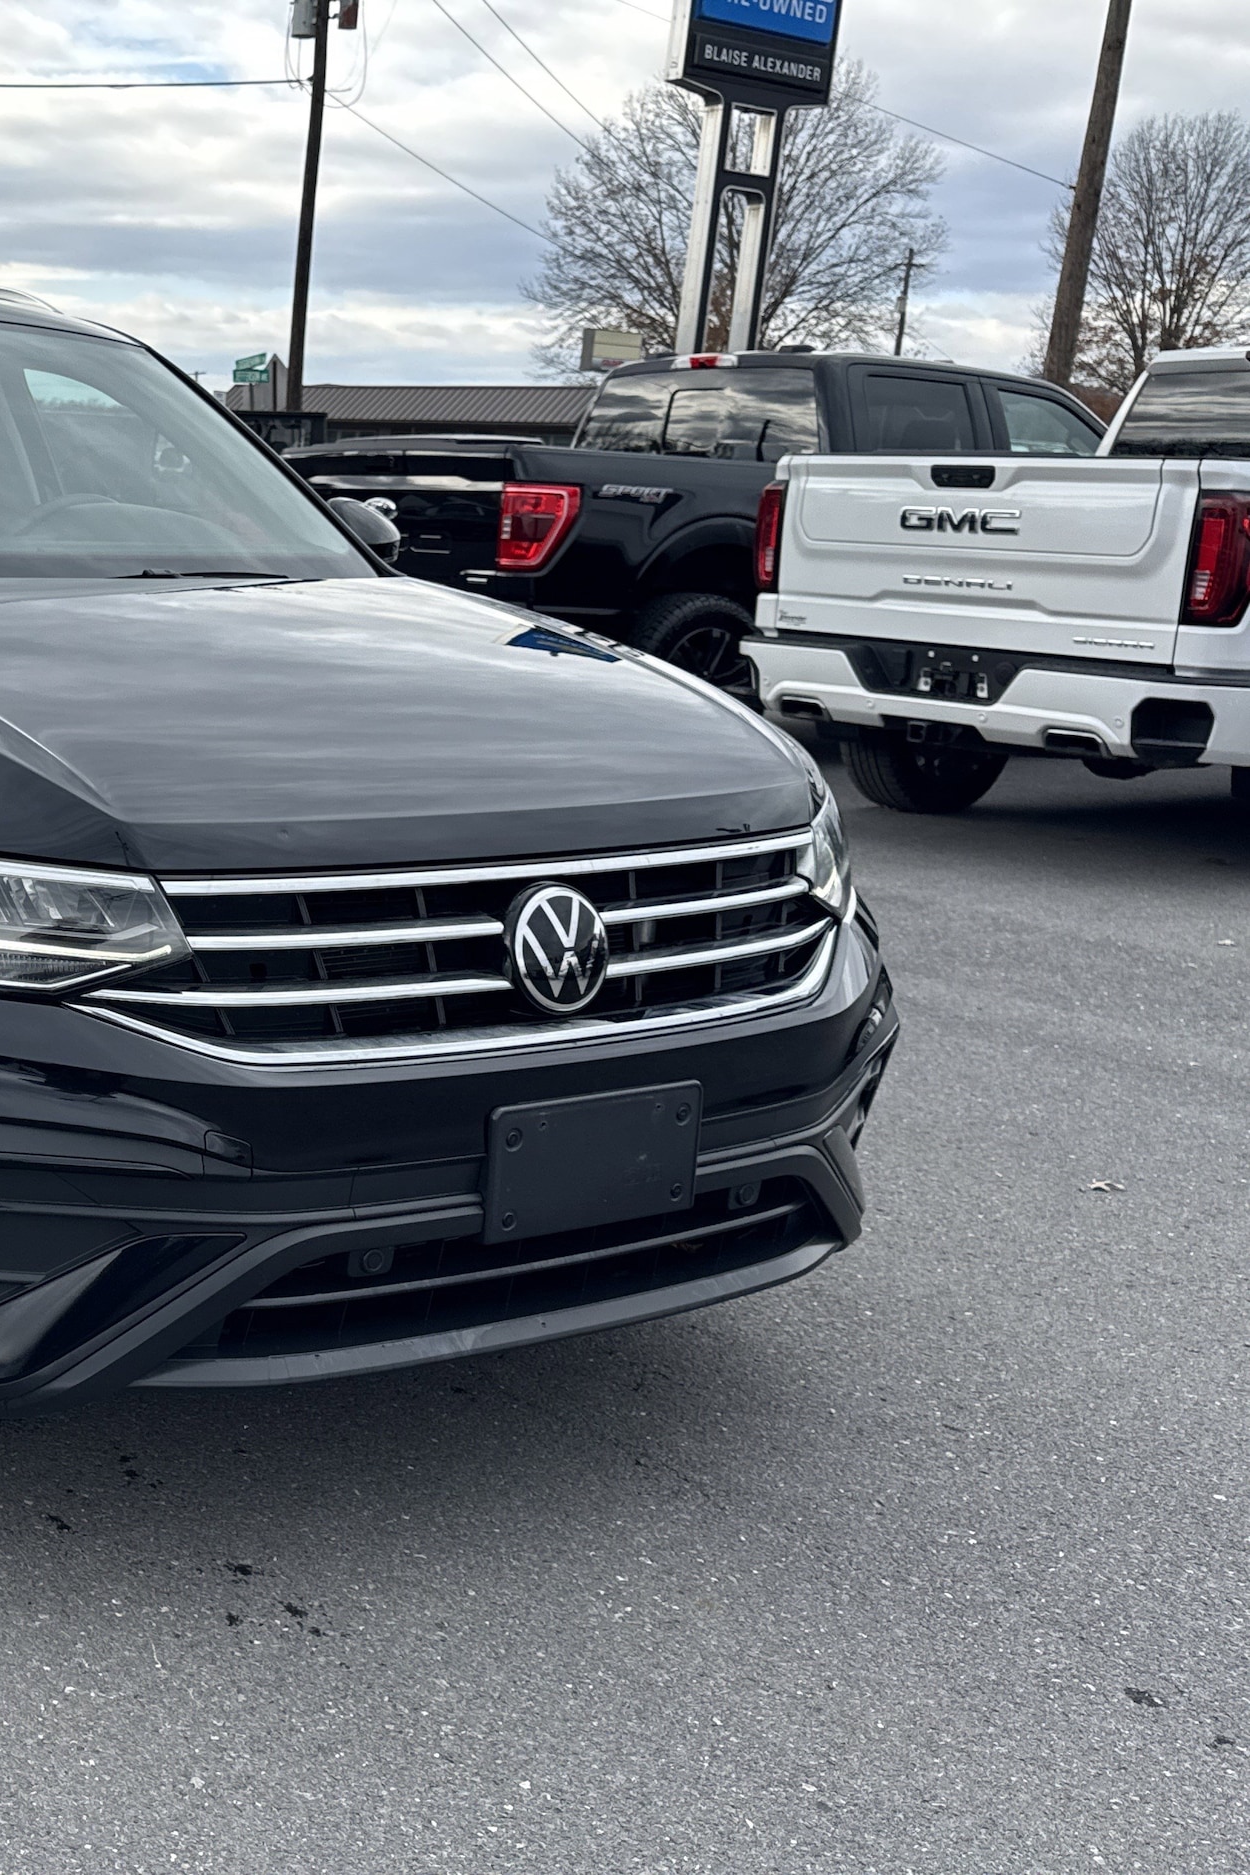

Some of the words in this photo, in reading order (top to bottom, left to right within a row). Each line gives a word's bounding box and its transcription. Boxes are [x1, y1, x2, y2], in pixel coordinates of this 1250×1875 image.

[728, 0, 828, 24] -OWNED
[704, 44, 749, 67] BLAISE
[753, 54, 822, 82] ALEXANDER
[598, 483, 674, 499] SPORT
[900, 505, 1021, 536] GMC
[902, 574, 1013, 591] DENALI
